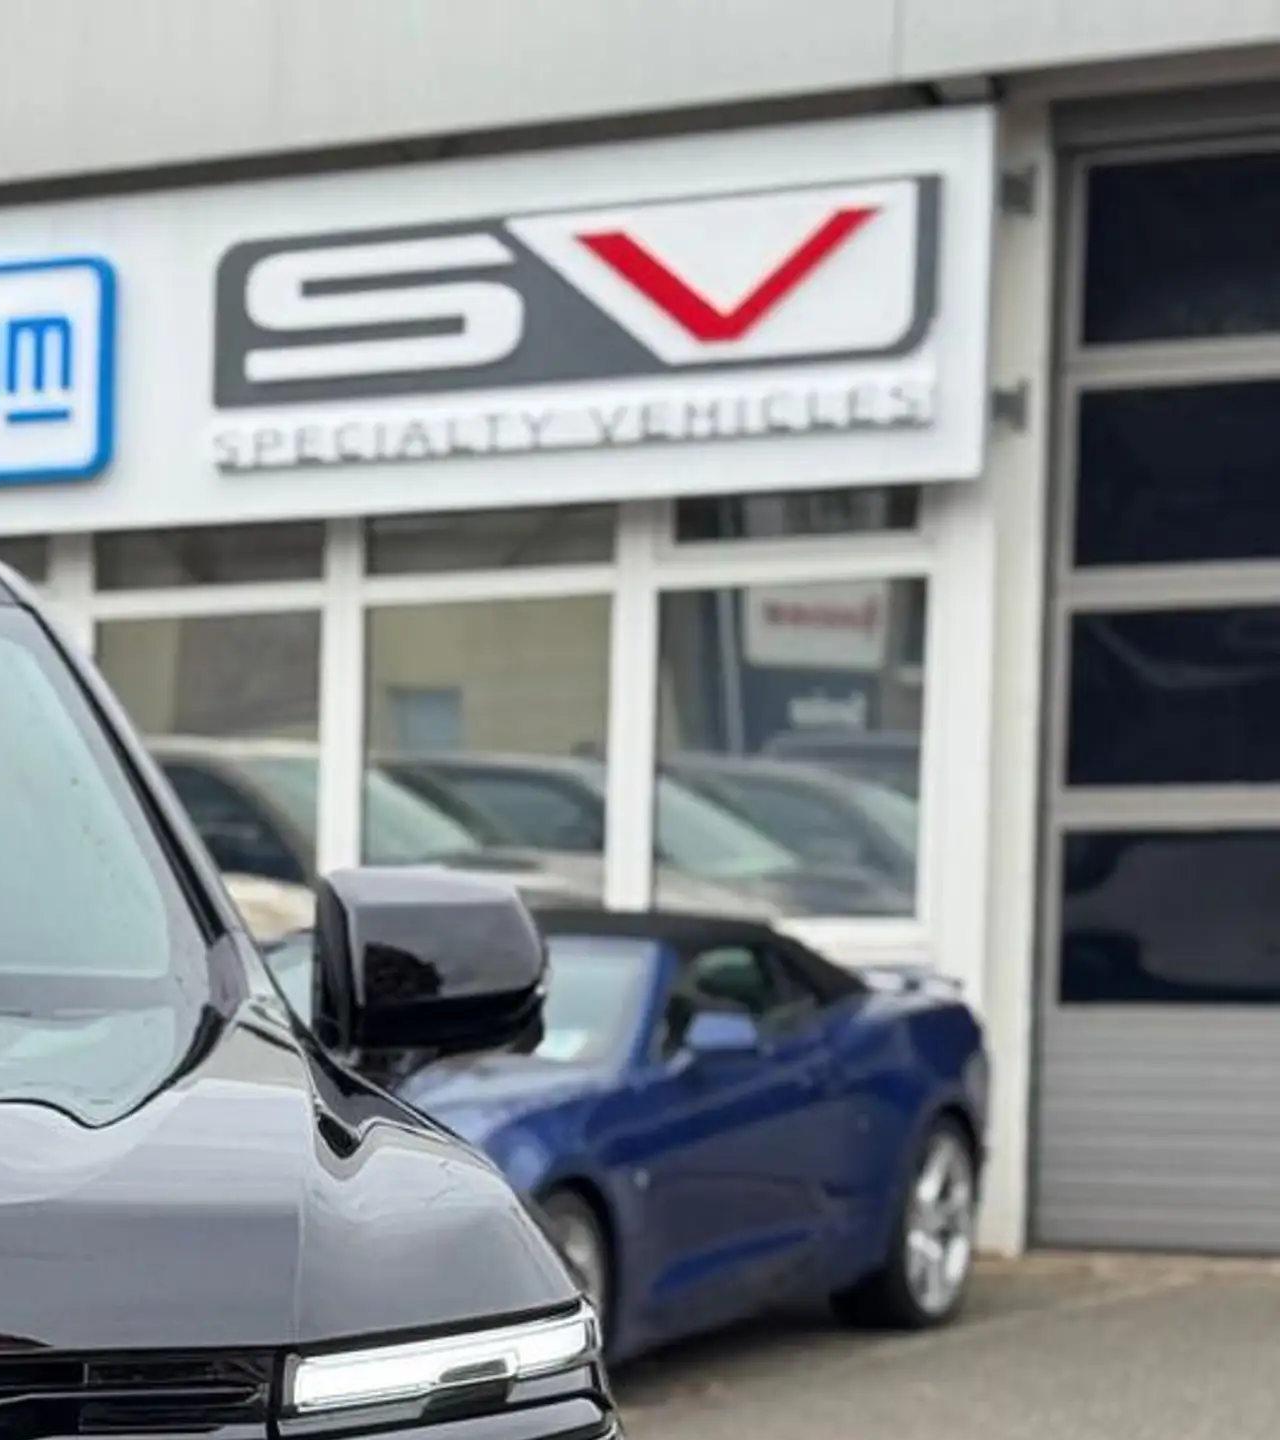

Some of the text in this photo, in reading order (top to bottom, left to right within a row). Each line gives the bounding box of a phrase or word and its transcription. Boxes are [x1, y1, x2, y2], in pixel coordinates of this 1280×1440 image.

[244, 208, 878, 382] SV
[212, 383, 931, 471] SPECIALTY VEHICLES
